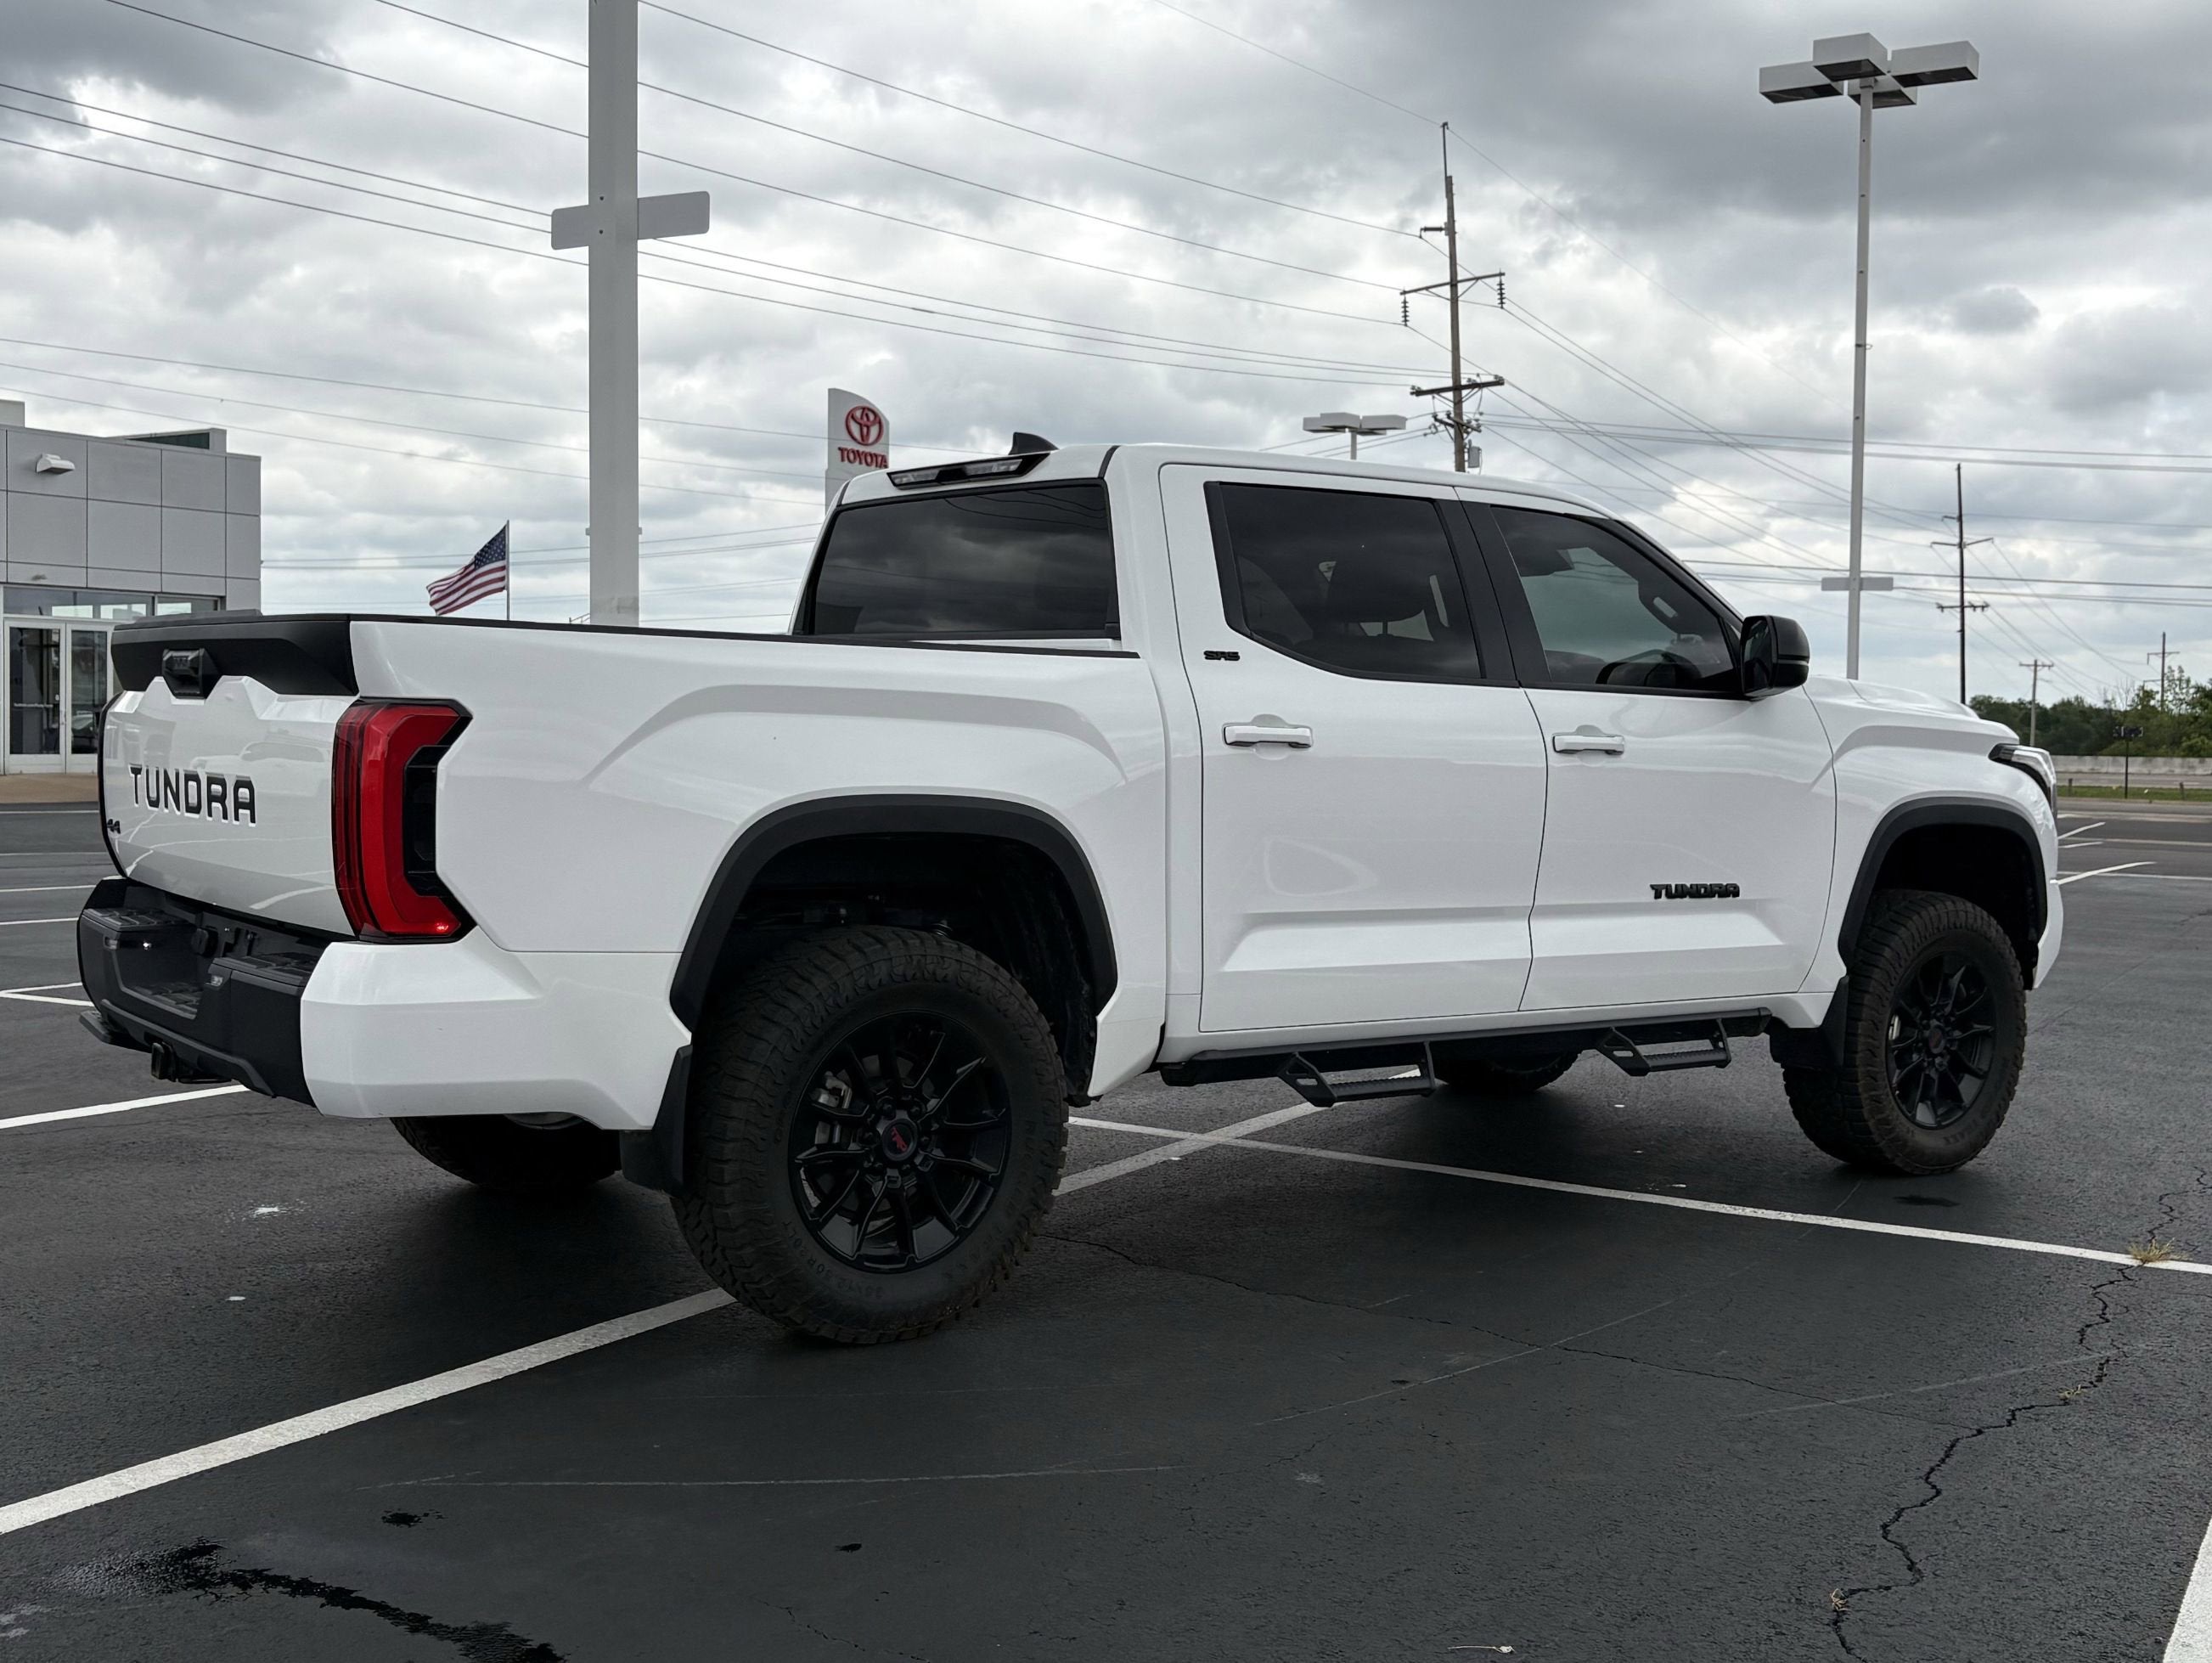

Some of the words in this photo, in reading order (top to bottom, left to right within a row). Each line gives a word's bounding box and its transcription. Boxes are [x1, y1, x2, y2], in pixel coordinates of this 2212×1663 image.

[837, 447, 889, 469] TOYOTA
[129, 764, 256, 827] TUNDRA
[1649, 882, 1740, 899] TUNDRA
